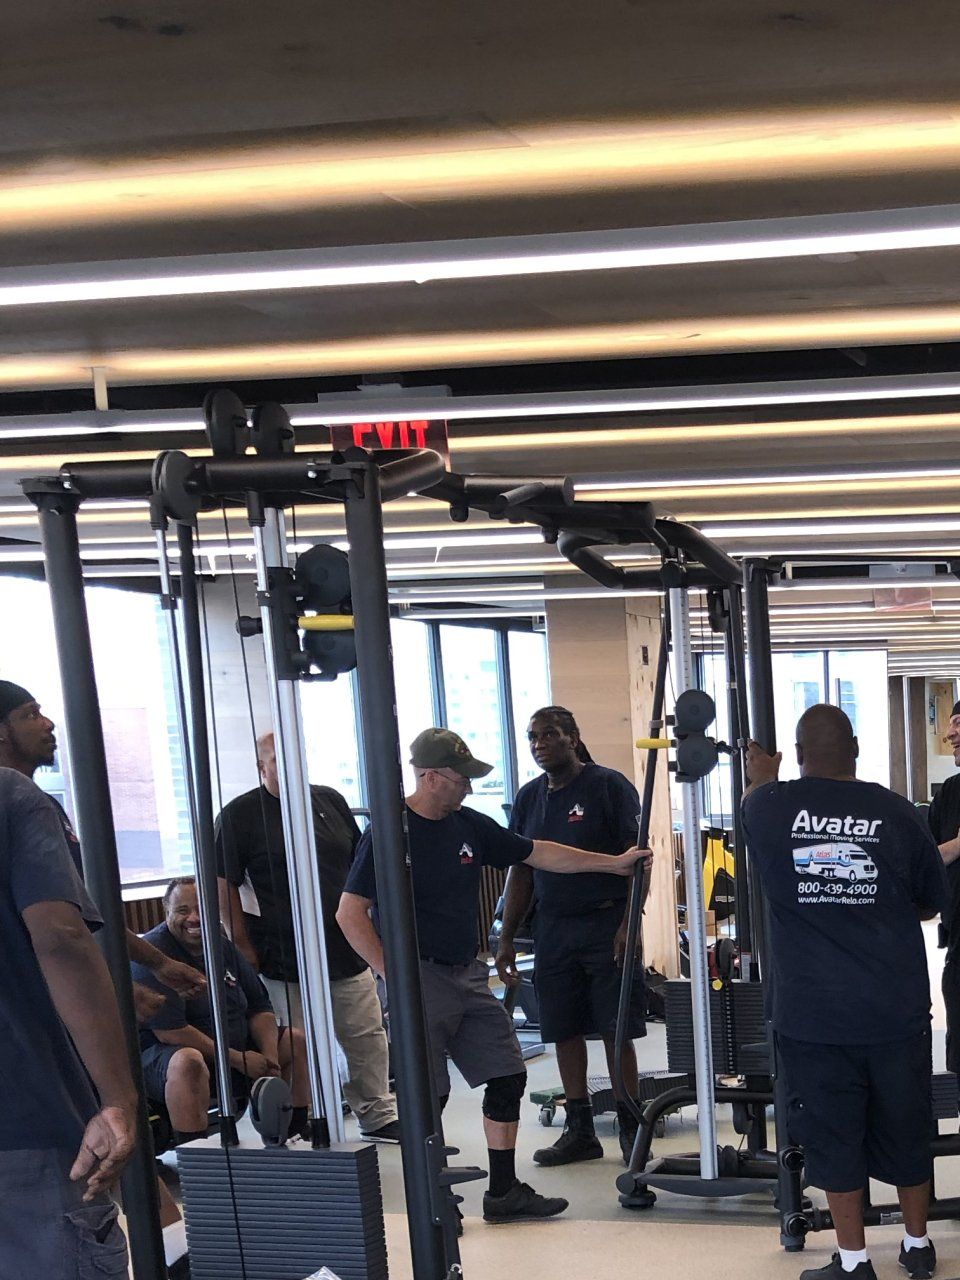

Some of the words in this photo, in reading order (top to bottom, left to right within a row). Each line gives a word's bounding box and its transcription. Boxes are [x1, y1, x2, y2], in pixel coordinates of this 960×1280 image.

[791, 809, 883, 836] Avatar
[791, 832, 829, 840] Professional
[829, 834, 854, 843] Moving
[797, 881, 878, 895] 800-439-4900
[797, 895, 876, 905] www.AvatarRelo.com
